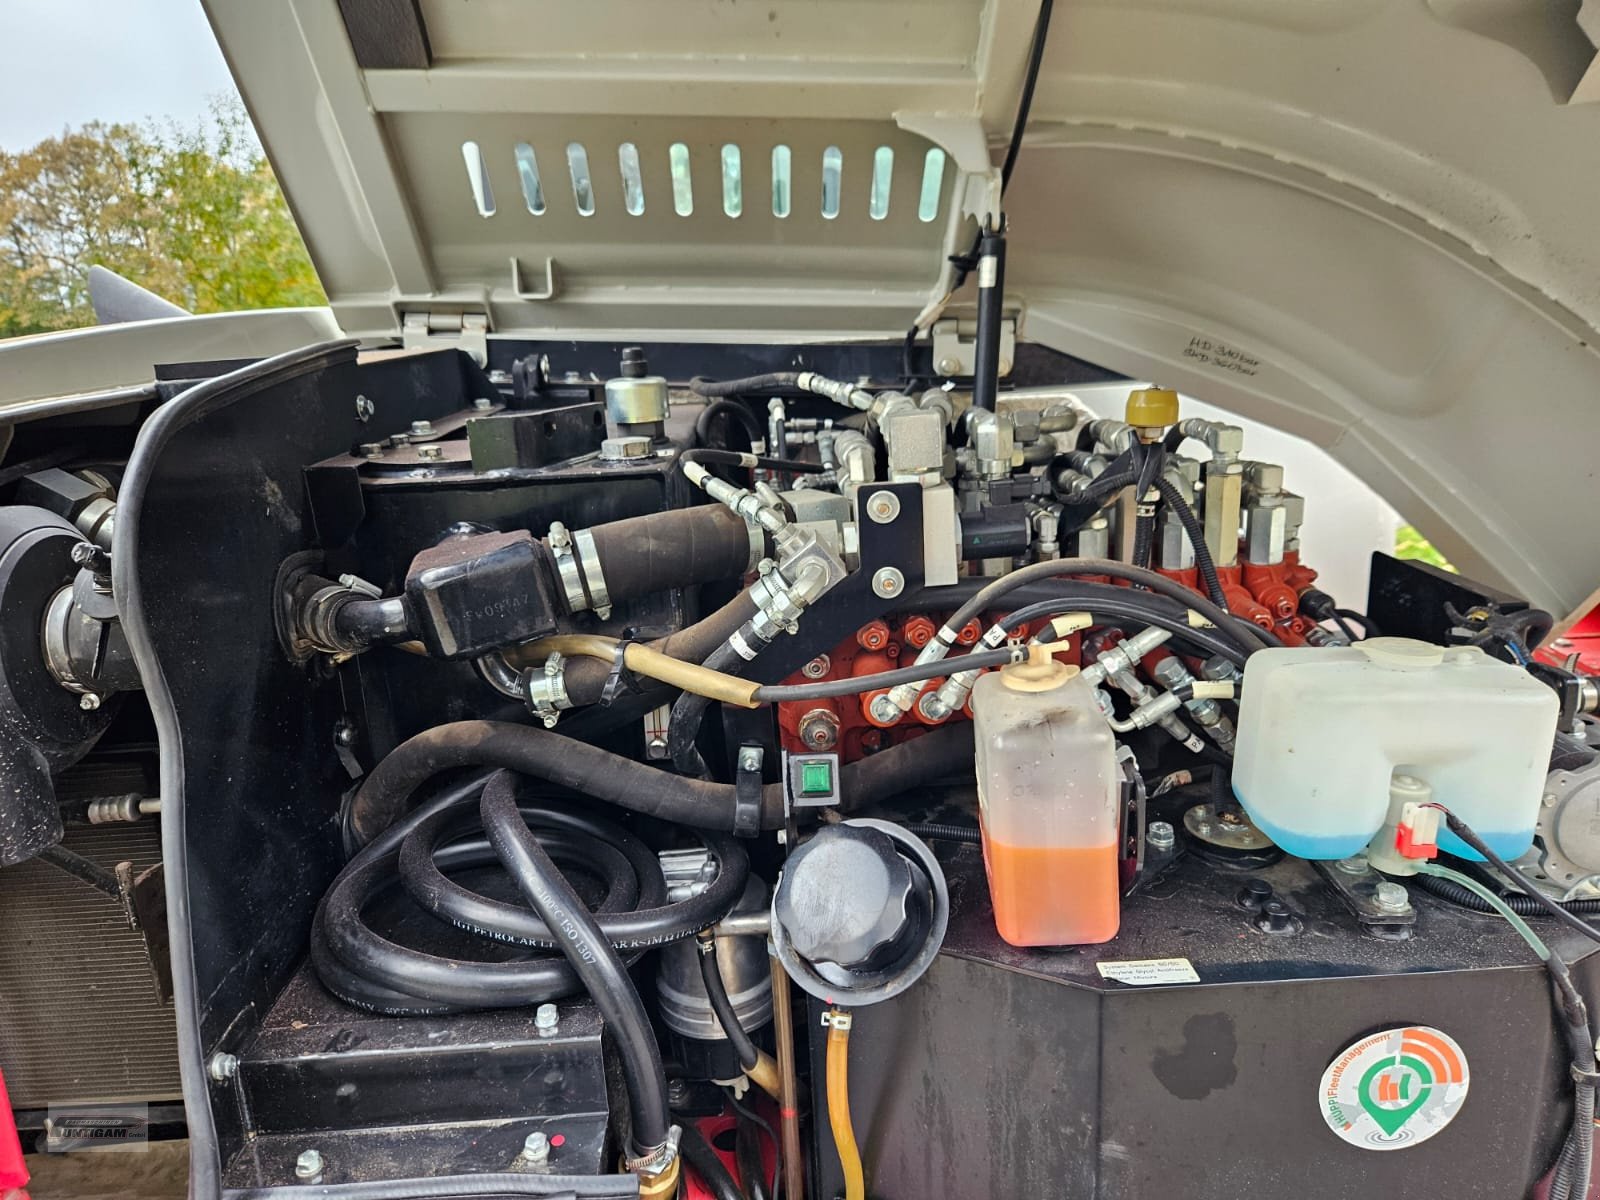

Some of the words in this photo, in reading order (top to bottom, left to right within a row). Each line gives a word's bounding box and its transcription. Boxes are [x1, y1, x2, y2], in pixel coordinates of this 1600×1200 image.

[560, 919, 578, 940] ISO
[575, 940, 597, 964] 1307
[611, 940, 628, 949] AR
